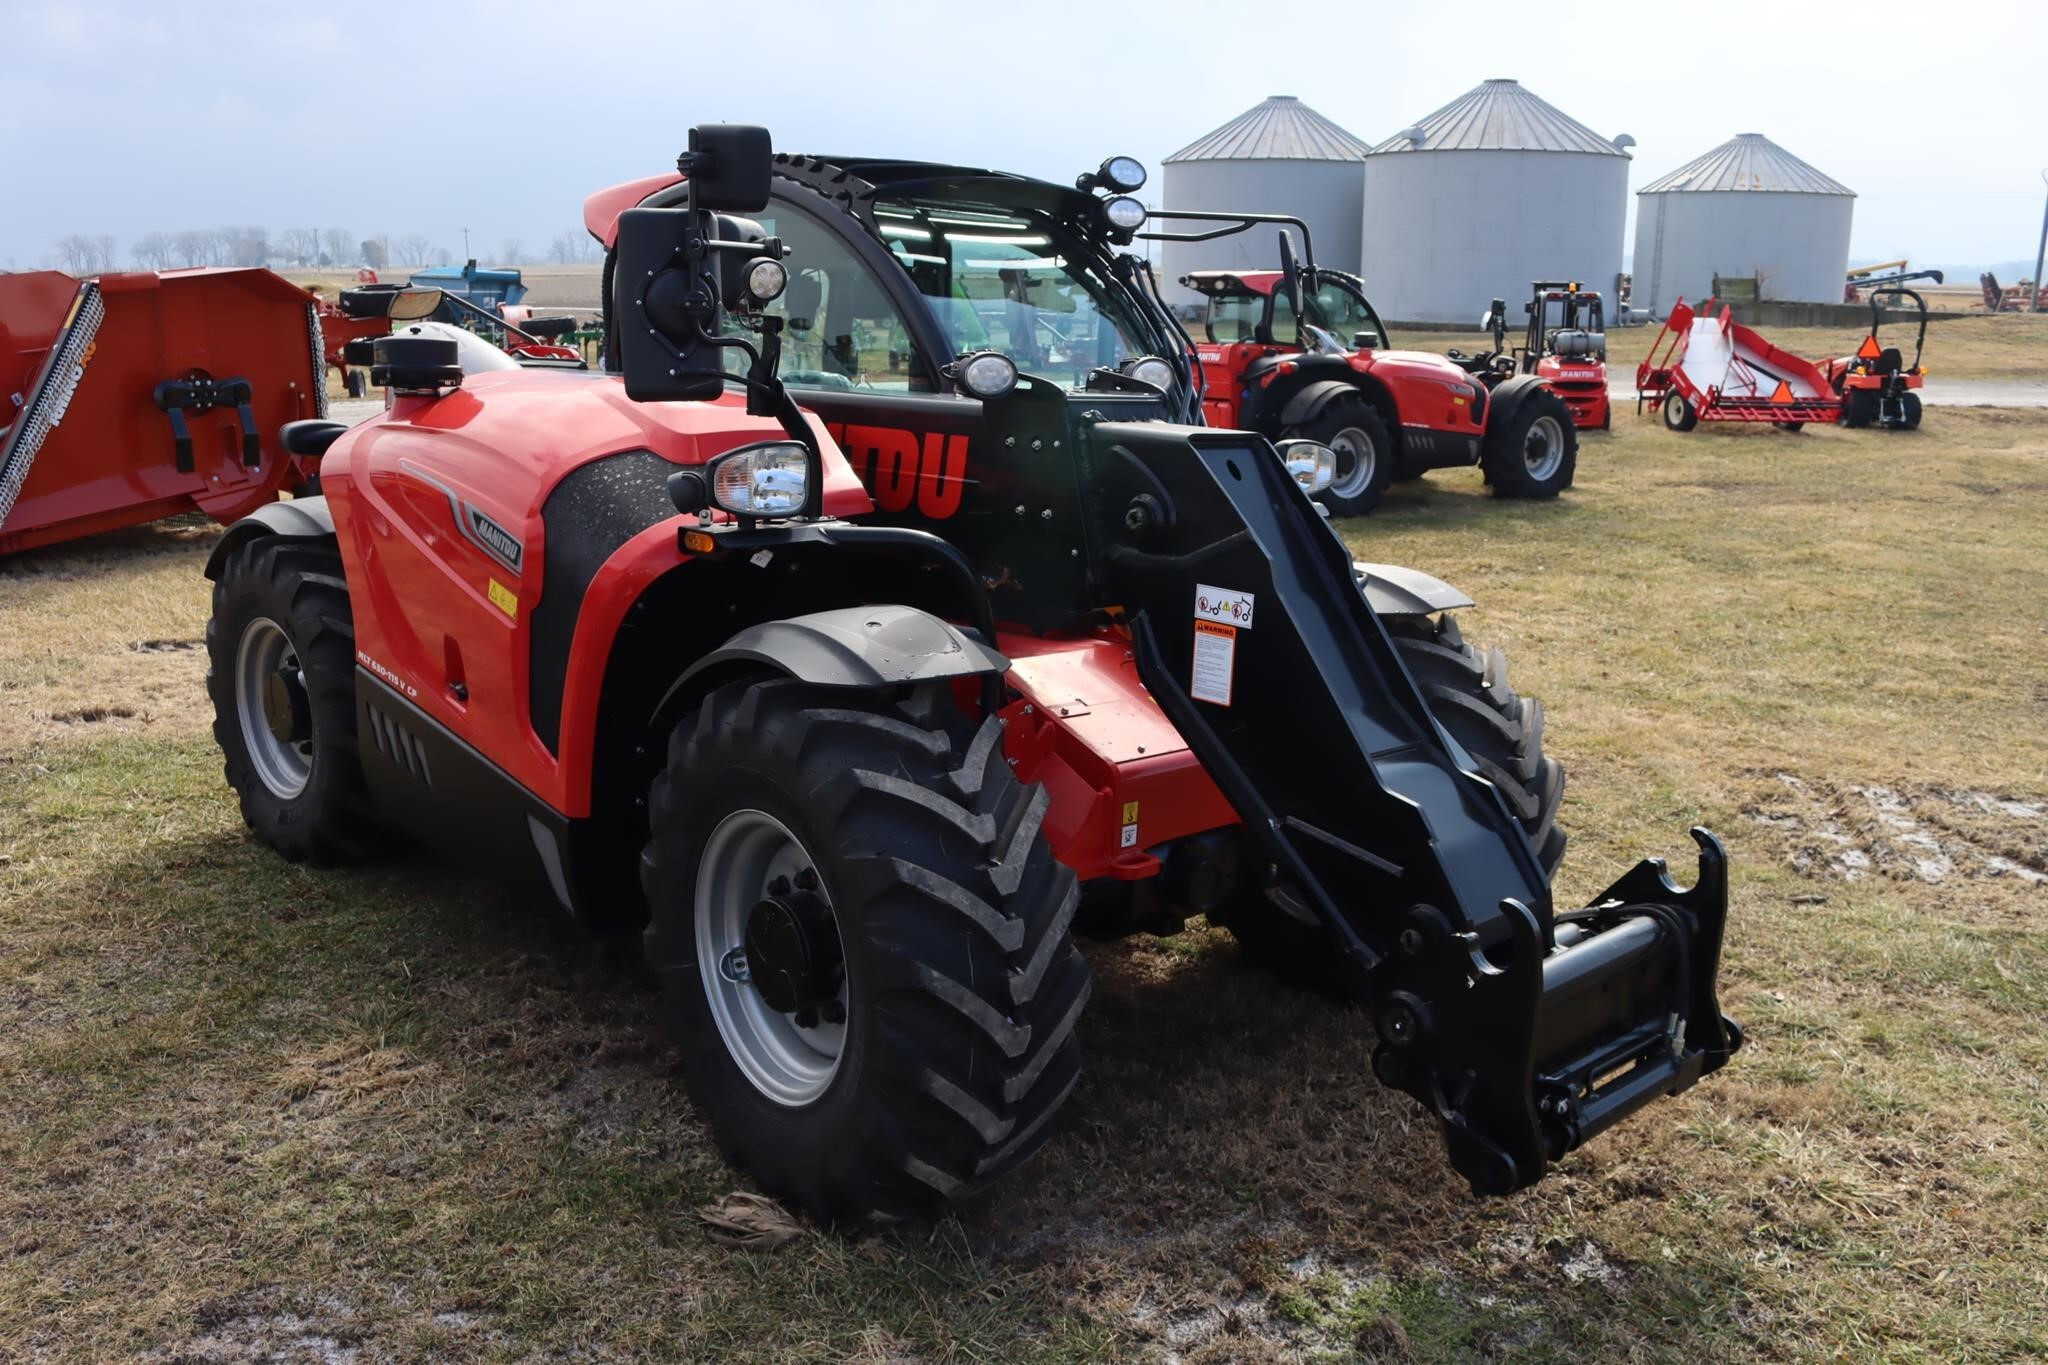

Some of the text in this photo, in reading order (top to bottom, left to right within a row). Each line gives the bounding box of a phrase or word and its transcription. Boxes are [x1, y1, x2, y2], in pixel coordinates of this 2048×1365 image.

[1560, 370, 1595, 378] MANITOU
[478, 519, 518, 560] MANITOU
[1203, 624, 1234, 637] WARNING
[358, 650, 371, 665] MLT
[371, 660, 399, 685] 630-115
[400, 680, 406, 690] V
